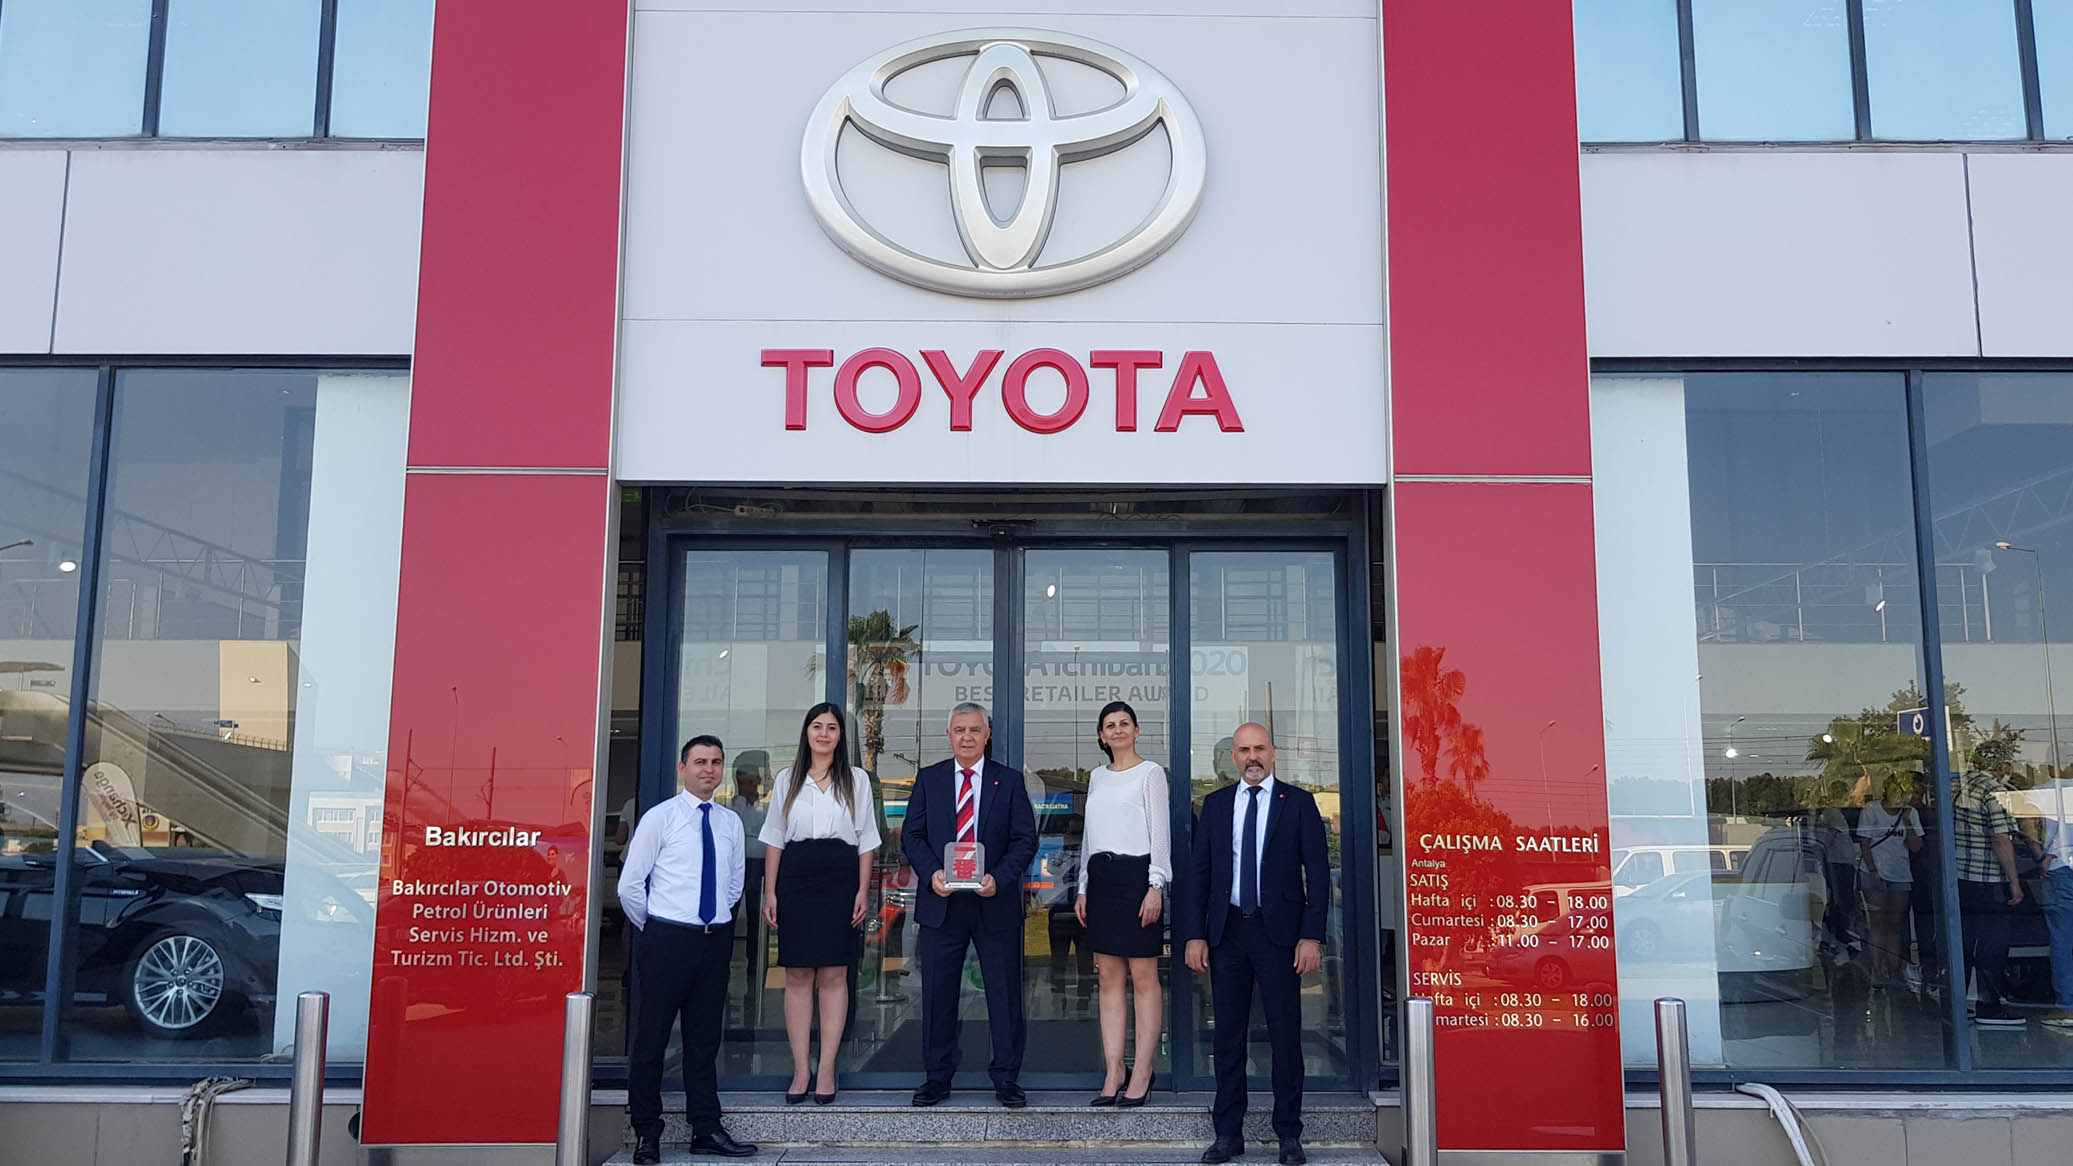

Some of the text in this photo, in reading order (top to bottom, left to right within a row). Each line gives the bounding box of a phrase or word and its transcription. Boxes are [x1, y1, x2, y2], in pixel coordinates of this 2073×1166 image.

[761, 347, 1245, 434] TOYOTA
[921, 652, 1047, 677] TOYA
[955, 686, 993, 701] BES
[1128, 686, 1208, 701] AWD
[425, 826, 541, 847] Bakırcılar
[1420, 833, 1599, 854] ÇALIŞMA SAATLERİ
[1411, 858, 1446, 869] Antalya
[392, 879, 572, 897] Bakırcılar Otomotiv
[1410, 874, 1448, 890] SATIŞ
[1410, 893, 1450, 907] Hafta
[1461, 894, 1476, 910] içi
[1568, 896, 1607, 910] 18.00
[413, 901, 548, 920] Petrol Ürünleri
[1411, 913, 1484, 927] Cumartesi
[1568, 915, 1608, 930] 17.00
[409, 926, 548, 943] Servis Hizm. ve
[1412, 933, 1450, 946] Pazar
[1569, 935, 1609, 949] 17.00
[391, 950, 563, 970] Turizm Tic. Ltd. Şti.
[1413, 969, 1462, 986] SERVİS
[1414, 992, 1453, 1006] fta
[1465, 993, 1480, 1010] içi
[1572, 993, 1612, 1007] 18.00
[1435, 1012, 1489, 1027] martesi
[1573, 1013, 1614, 1028] 16.00
